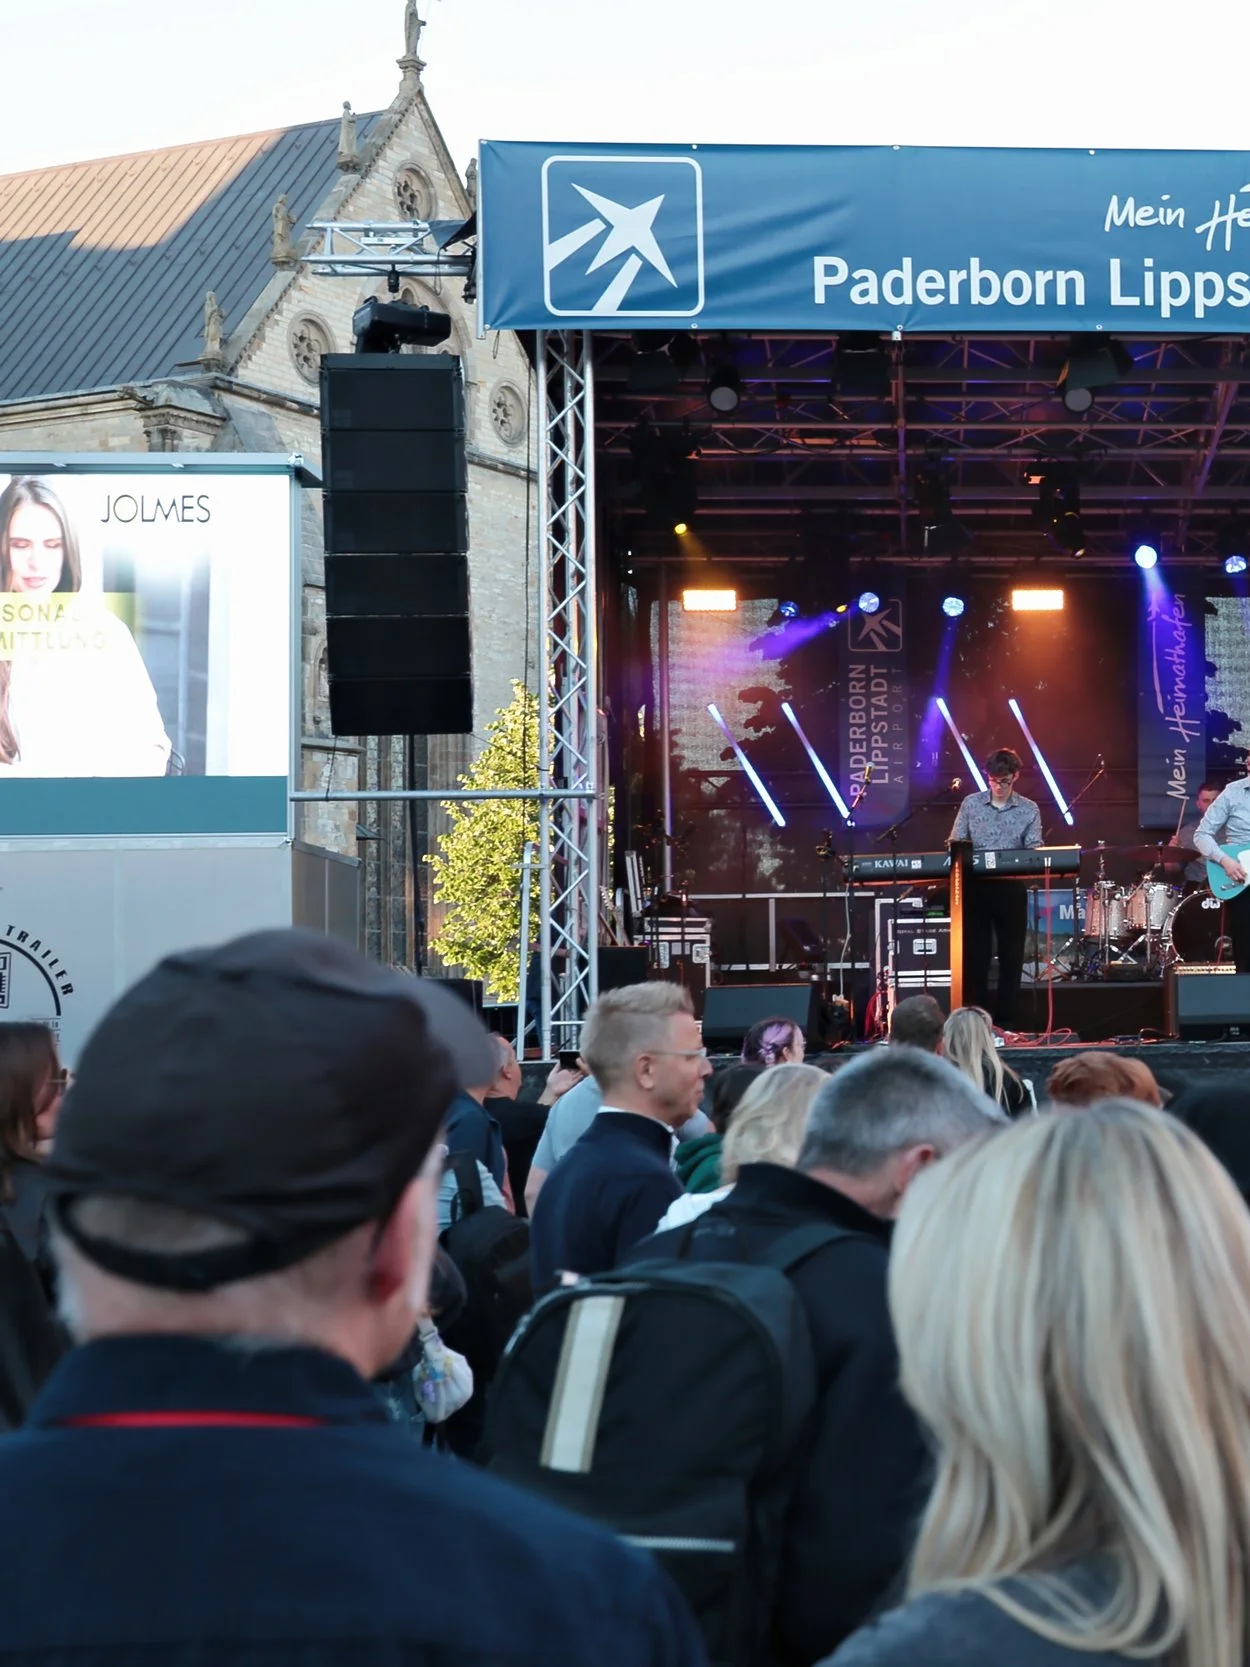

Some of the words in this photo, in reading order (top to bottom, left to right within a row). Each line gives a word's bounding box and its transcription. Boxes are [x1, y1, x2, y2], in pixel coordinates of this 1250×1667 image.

[1104, 194, 1185, 233] Mein
[812, 255, 1086, 306] Paderborn
[101, 494, 211, 523] JOLMES
[1161, 593, 1200, 743] Heimathafen
[849, 664, 867, 797] PADERBORN
[870, 664, 888, 784] LIPPSTADT
[892, 666, 904, 784] AIRPORT
[1166, 749, 1189, 800] Mein
[874, 858, 909, 869] KAWAI
[6, 924, 74, 996] TRAILER
